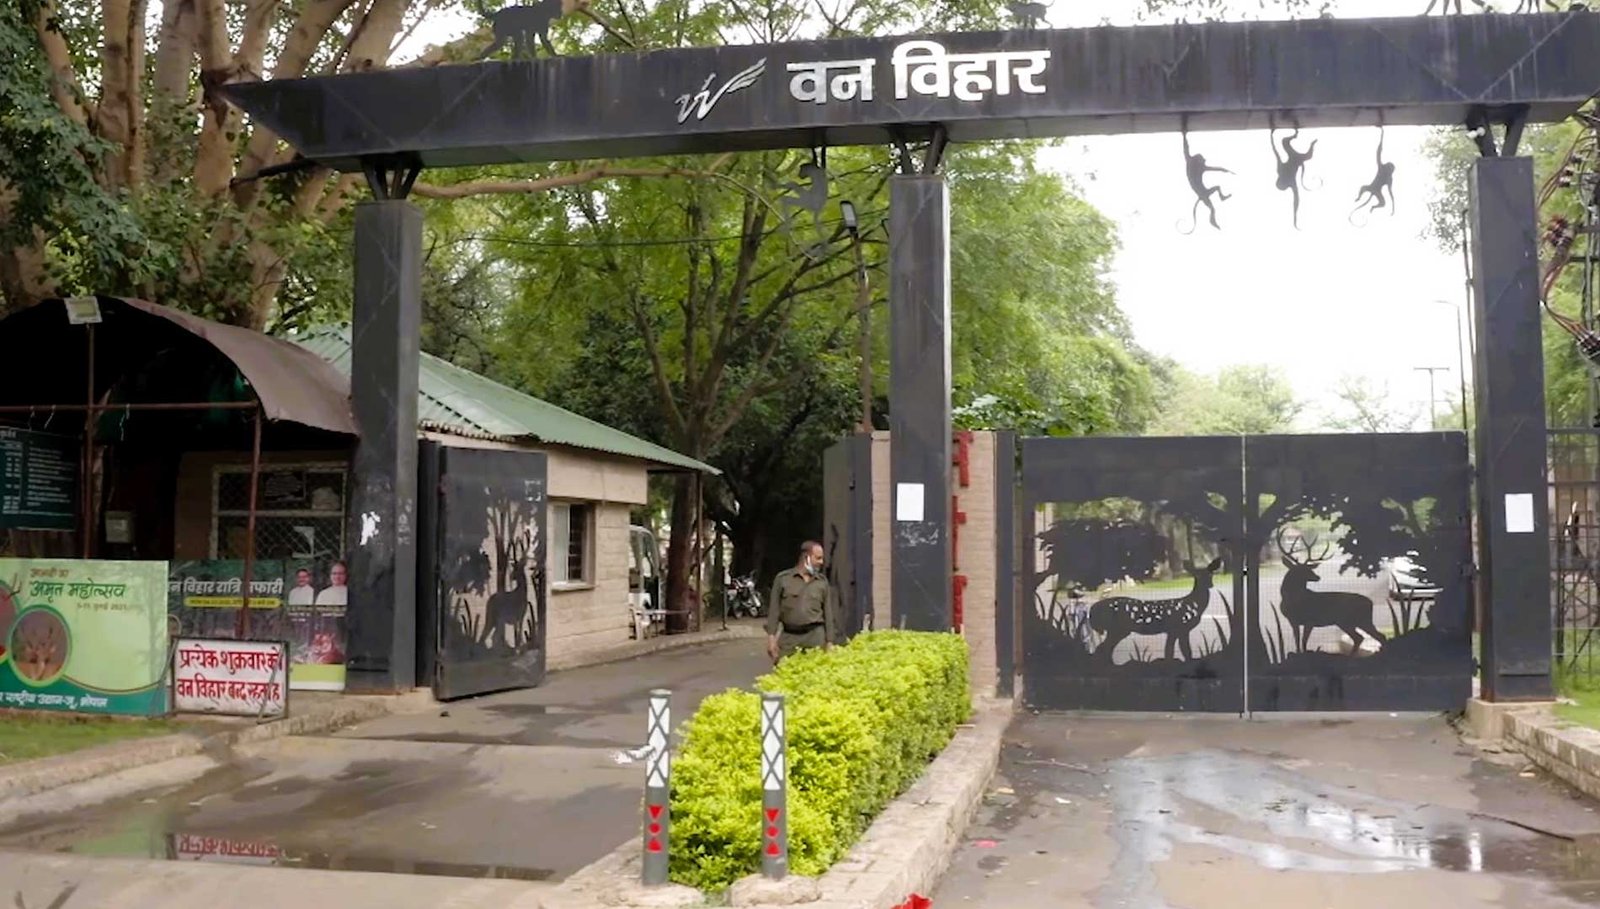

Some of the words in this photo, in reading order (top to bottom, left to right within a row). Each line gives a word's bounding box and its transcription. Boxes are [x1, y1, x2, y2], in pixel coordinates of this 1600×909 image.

[786, 58, 875, 104] वन
[891, 40, 1051, 101] विहार
[30, 580, 63, 603] अमृत
[68, 577, 126, 600] महोत्सव
[168, 577, 182, 594] न
[183, 576, 214, 594] विहार
[217, 576, 242, 594] रात्रि
[249, 576, 284, 595] फारी
[179, 643, 219, 668] प्रत्येक
[80, 691, 108, 708] भोपाल
[176, 678, 194, 698] वन
[194, 671, 229, 705] विहार
